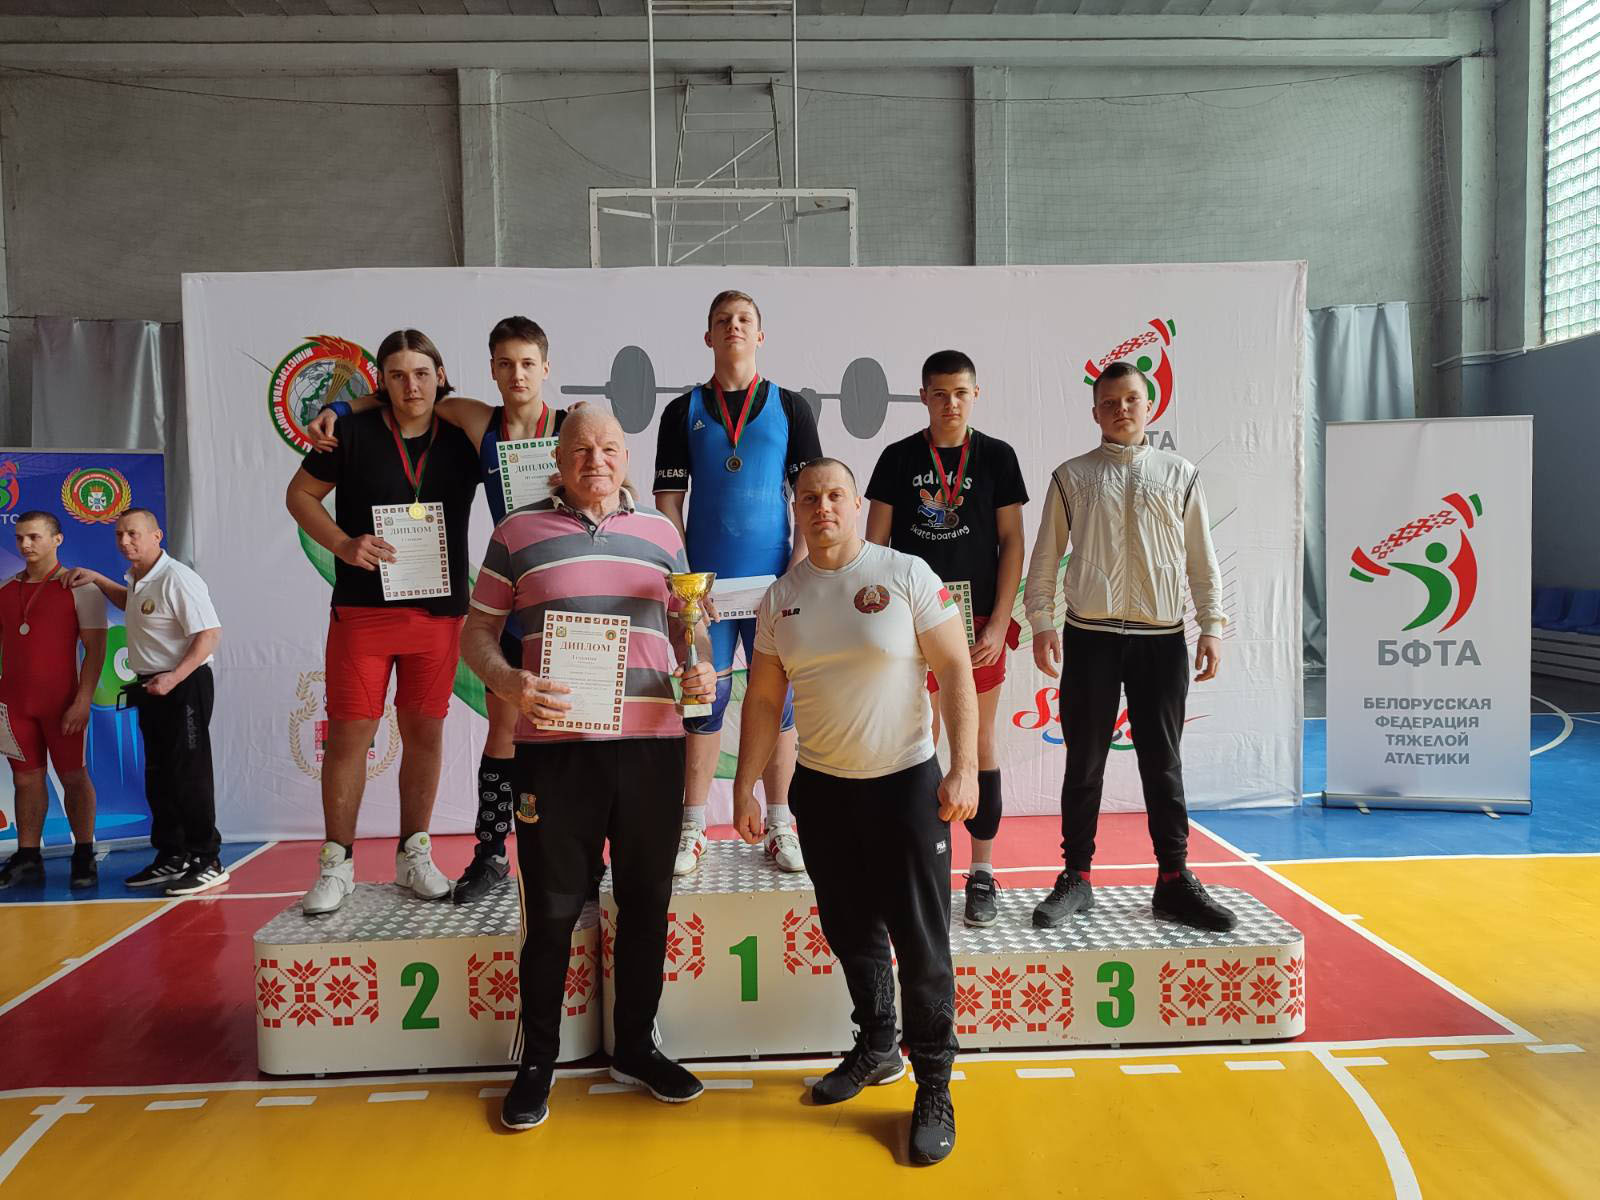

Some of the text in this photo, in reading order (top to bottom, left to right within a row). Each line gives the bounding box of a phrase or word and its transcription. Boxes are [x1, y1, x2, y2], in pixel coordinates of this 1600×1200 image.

[274, 406, 296, 441] СПОРТУ
[1143, 430, 1176, 450] ТА
[657, 468, 688, 479] PLEASE
[912, 469, 973, 490] adids
[391, 526, 432, 535] ДИПЛОМ
[559, 641, 611, 652] ДИПЛОМ
[1378, 639, 1482, 667] БФТА
[1364, 697, 1492, 710] БЕЛОРУССКАЯ
[1375, 715, 1479, 730] ФЕДЕРАЦИЯ
[1385, 732, 1469, 747] ТЯЖЕЛОЙ
[1384, 752, 1470, 765] АТЛЕТИКИ
[729, 936, 759, 1002] 1
[400, 961, 440, 1030] 2
[1097, 961, 1135, 1028] 3
